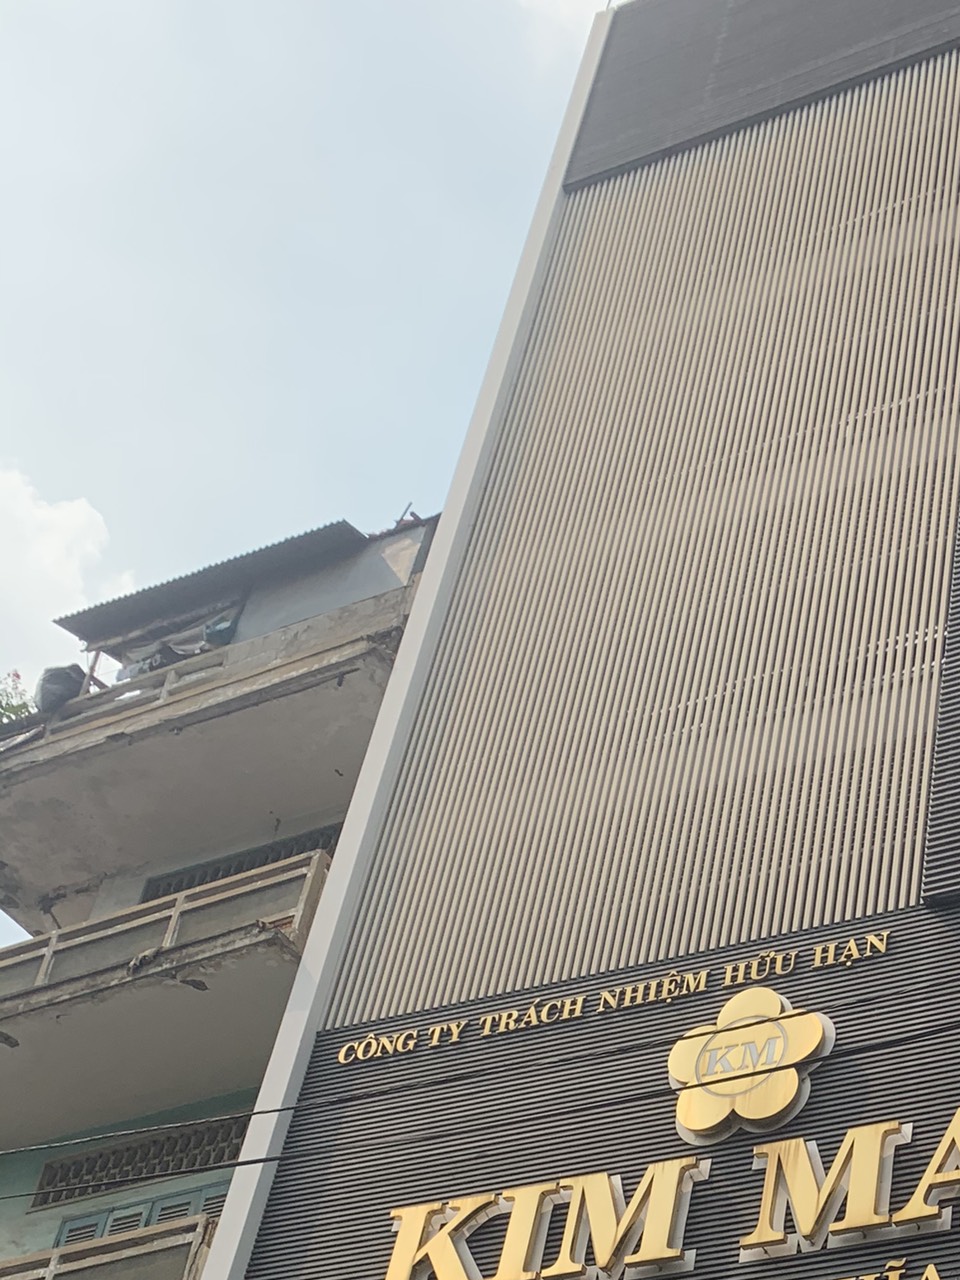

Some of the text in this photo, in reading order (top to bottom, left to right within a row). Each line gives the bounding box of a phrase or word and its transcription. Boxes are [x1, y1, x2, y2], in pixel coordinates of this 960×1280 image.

[337, 931, 891, 1065] CÔNG TY TRÁCH NHIỆM HỮU HẠN
[702, 1036, 782, 1076] KM
